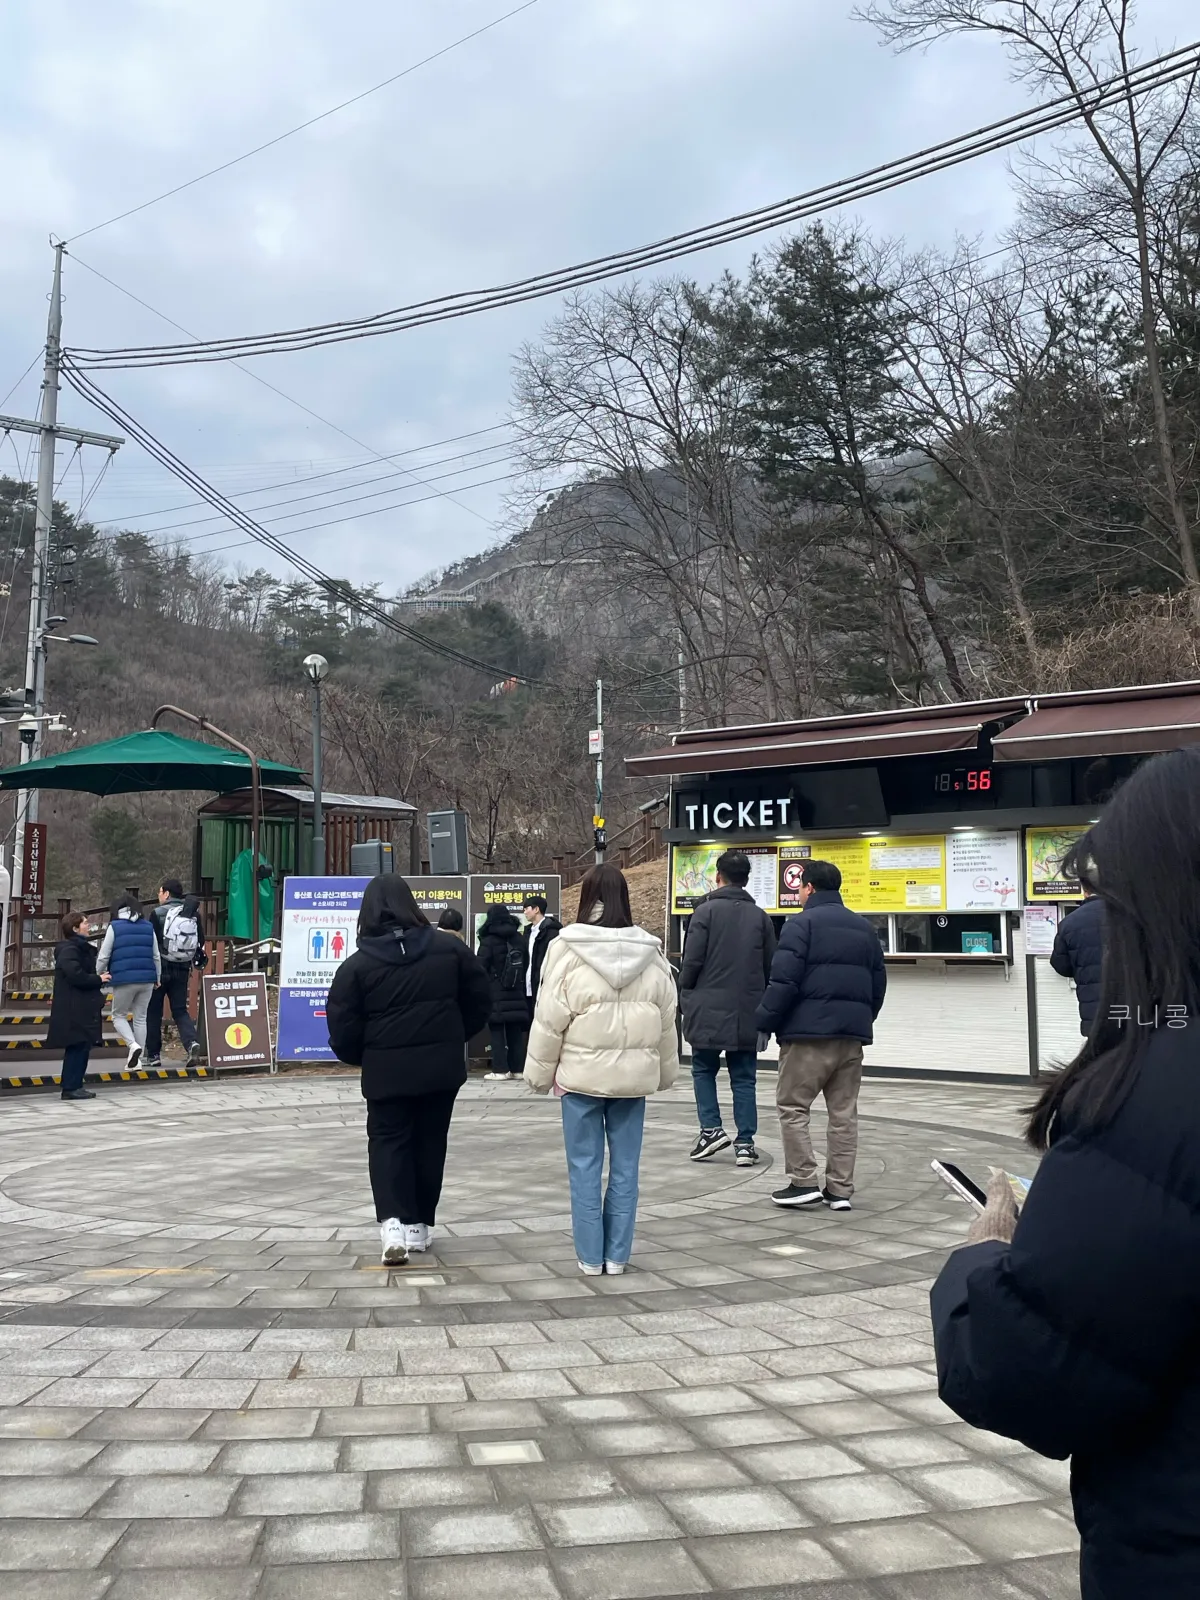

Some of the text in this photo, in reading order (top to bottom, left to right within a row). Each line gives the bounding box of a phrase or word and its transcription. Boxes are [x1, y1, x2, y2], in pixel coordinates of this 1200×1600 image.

[967, 770, 991, 790] 56
[685, 798, 791, 830] TICKET
[428, 890, 462, 900] 이용안내
[483, 892, 523, 904] 일방통행
[965, 937, 988, 948] CLOSE
[211, 982, 231, 991] 소금산
[214, 994, 258, 1019] 입구
